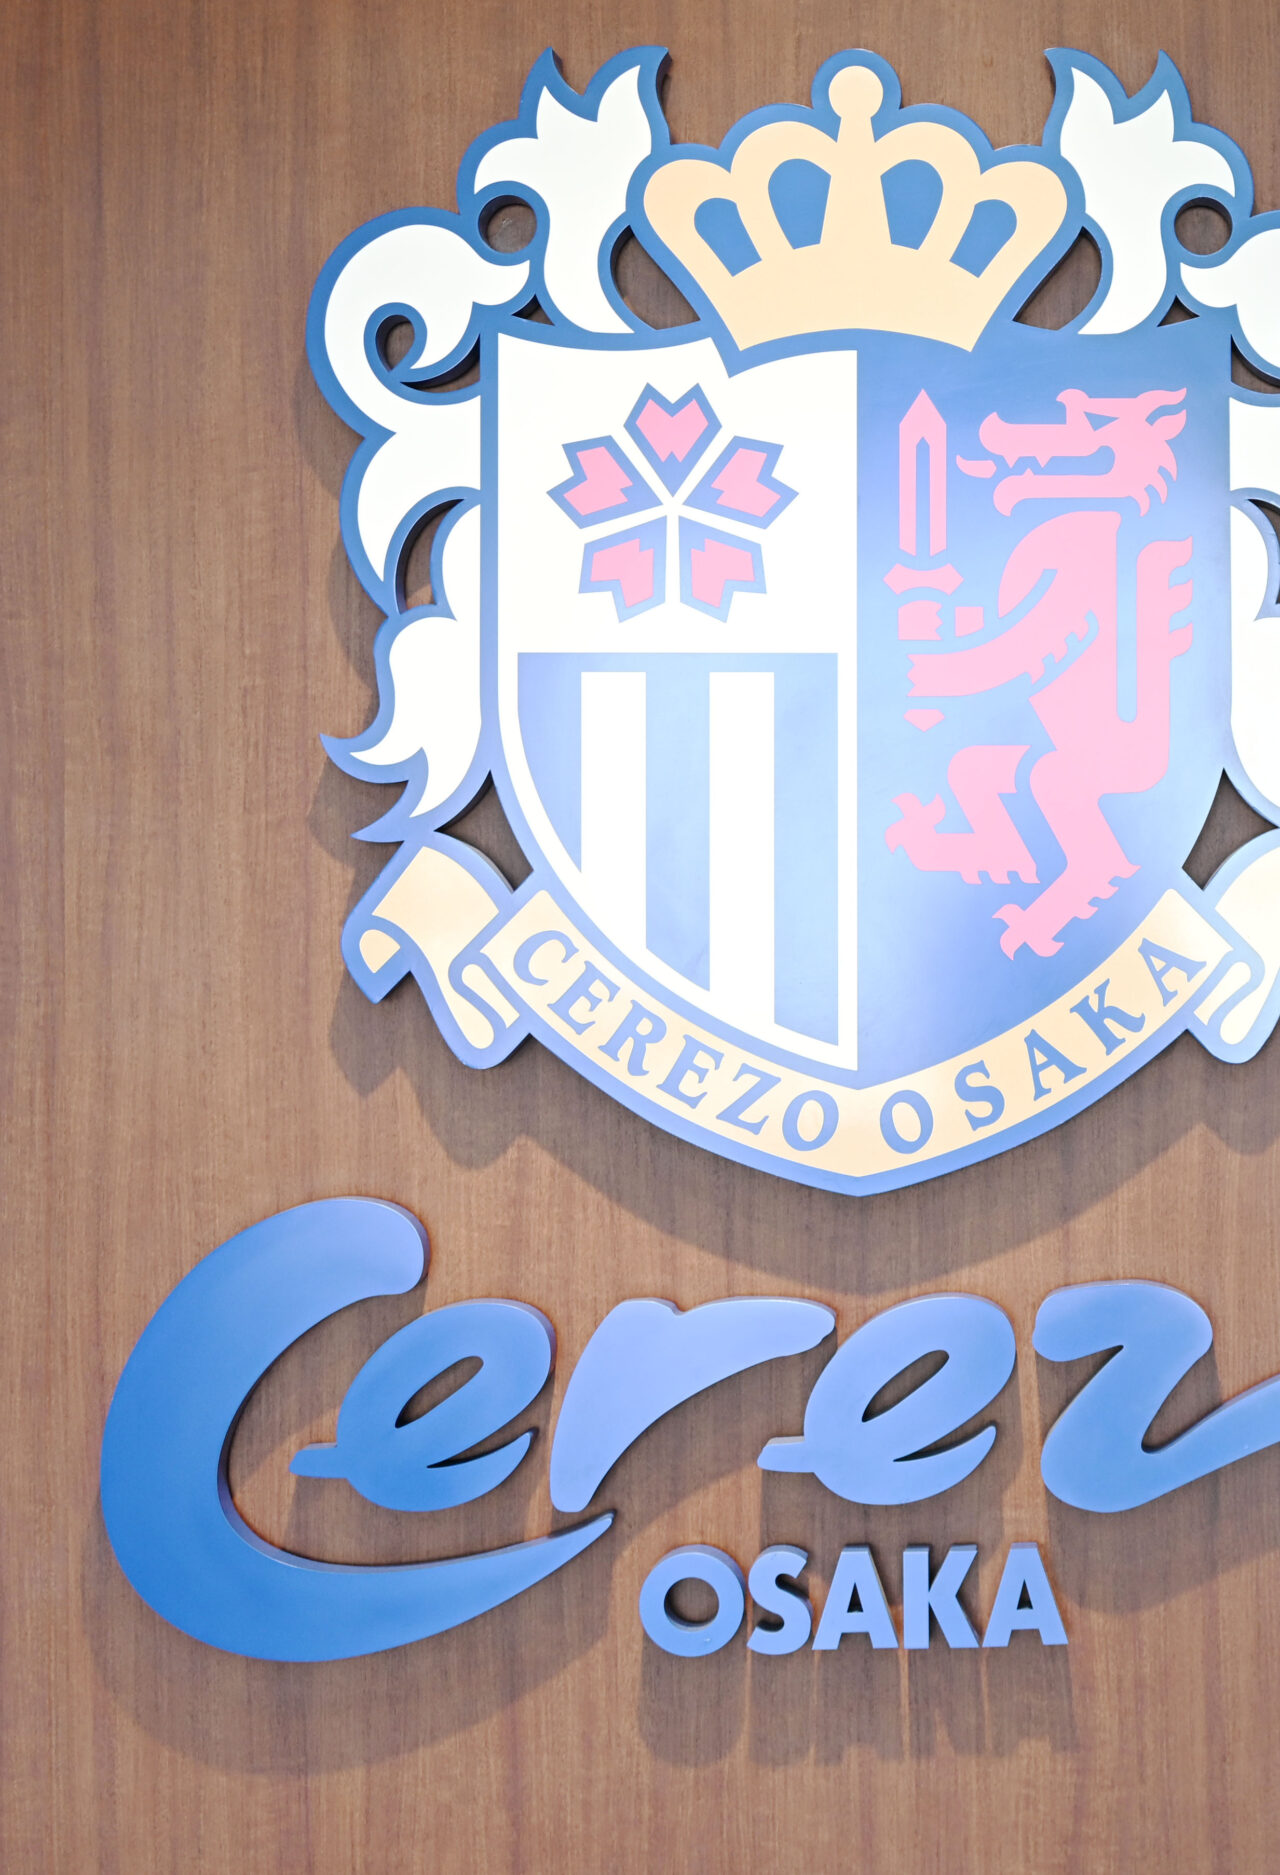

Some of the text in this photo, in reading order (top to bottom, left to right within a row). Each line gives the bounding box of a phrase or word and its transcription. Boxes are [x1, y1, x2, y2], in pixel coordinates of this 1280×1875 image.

[512, 929, 1208, 1155] CEREZO OSAKA
[640, 1542, 1069, 1658] OSAKA
